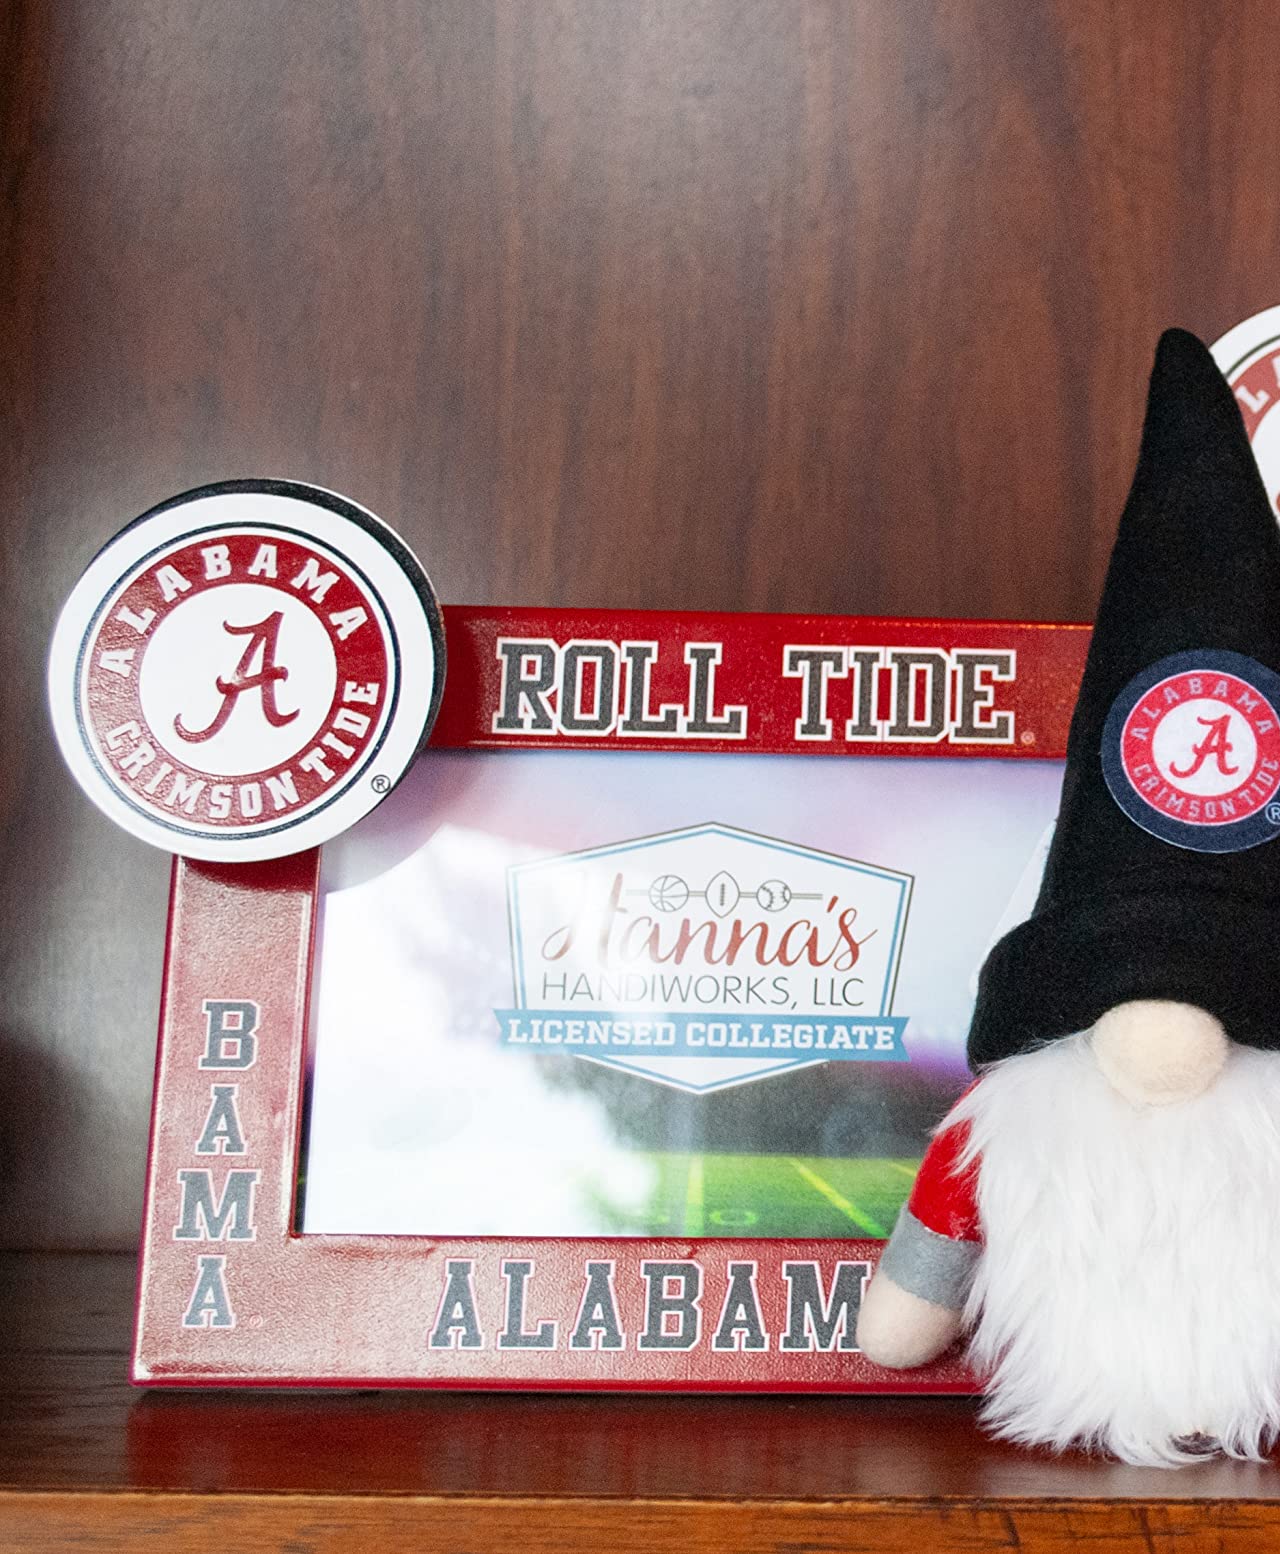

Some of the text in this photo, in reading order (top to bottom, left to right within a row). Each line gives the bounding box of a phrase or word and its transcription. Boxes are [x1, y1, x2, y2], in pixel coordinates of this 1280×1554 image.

[99, 543, 369, 678] ALABAMA
[173, 611, 300, 743] A
[491, 637, 1017, 744] ROLL TIDE
[1131, 678, 1273, 741] ALABAMA
[106, 680, 379, 819] CRIMSON TIDE
[1134, 757, 1279, 818] CRIMSON TIDE
[1169, 714, 1239, 779] A
[541, 873, 878, 971] Hanna's
[507, 1018, 894, 1051] LICENSED COLLEGIATE
[542, 972, 865, 1010] HANDIWORKS, LLC
[172, 999, 261, 1329] BAMA
[428, 1258, 872, 1352] ALABAM
